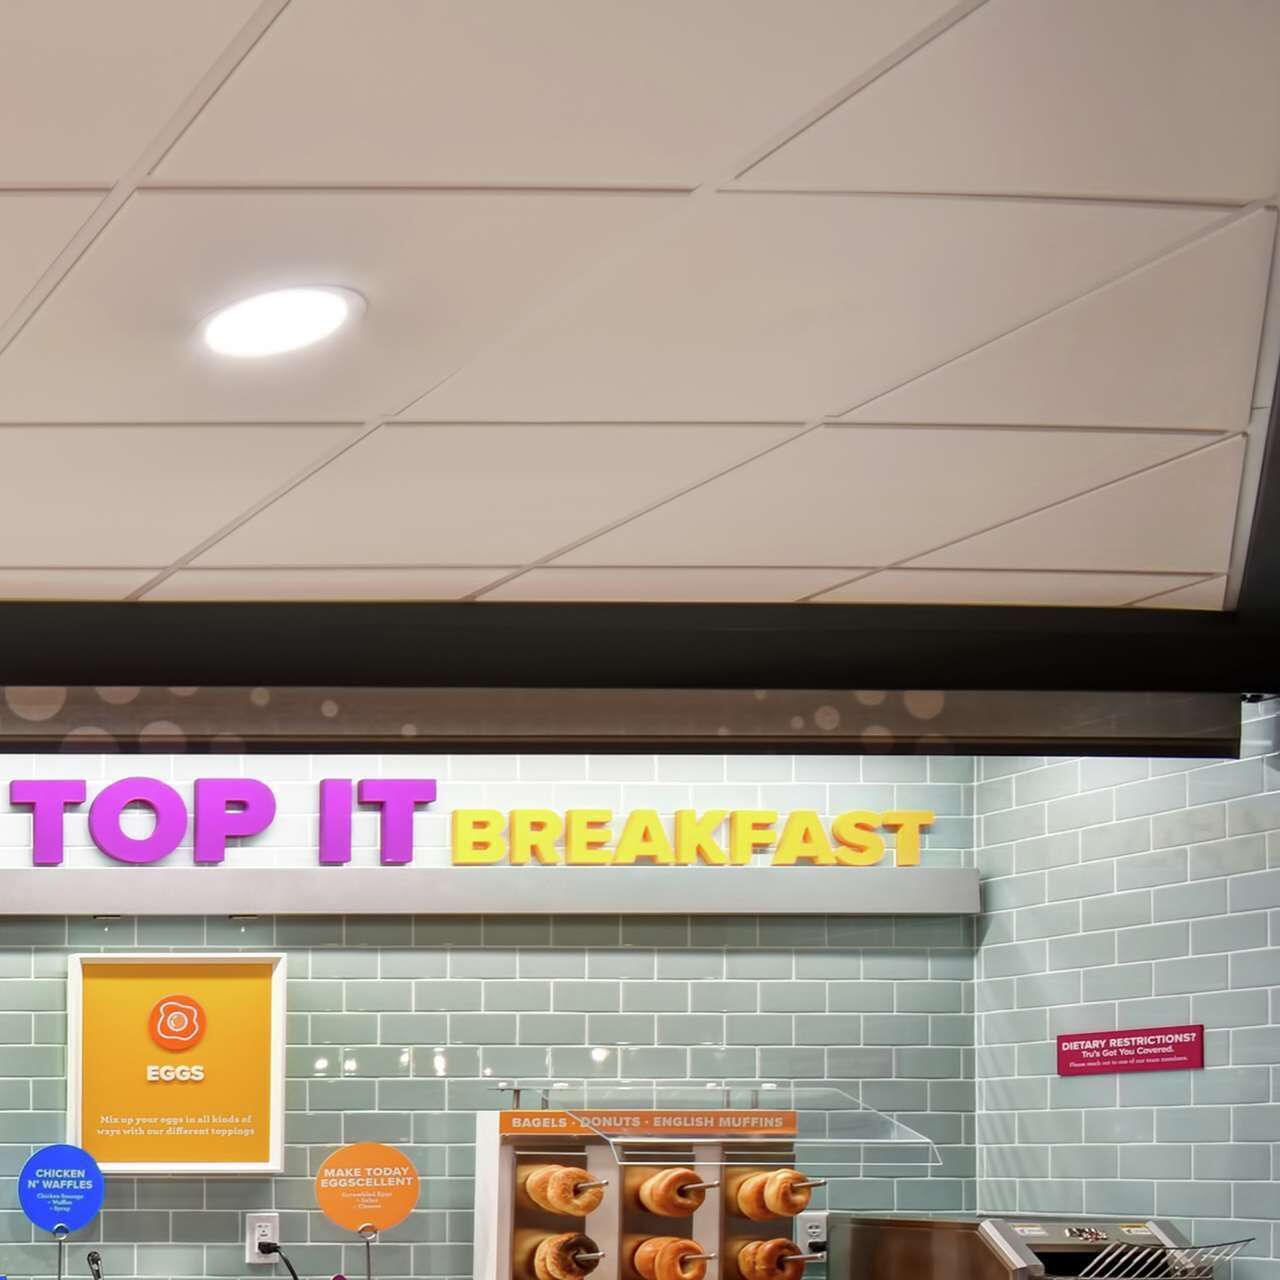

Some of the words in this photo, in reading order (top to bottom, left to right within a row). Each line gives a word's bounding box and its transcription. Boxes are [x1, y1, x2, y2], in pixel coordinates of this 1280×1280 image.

[10, 776, 276, 866] TOP
[319, 778, 436, 866] IT
[451, 807, 935, 867] BREAKFAST
[1062, 1039, 1107, 1051] DIETARY
[1109, 1033, 1196, 1049] RESTRICTIONS?
[1102, 1049, 1118, 1057] Got
[1120, 1047, 1135, 1056] You
[1137, 1045, 1175, 1055] Covered.
[147, 1065, 205, 1081] EGGS
[100, 1115, 120, 1124] Mix
[121, 1116, 135, 1126] up
[136, 1116, 160, 1126] your
[161, 1116, 184, 1126] eggs
[186, 1115, 196, 1124] in
[197, 1115, 211, 1124] all
[212, 1115, 240, 1124] kinds
[242, 1115, 253, 1124] of
[511, 1116, 568, 1128] BAGELS
[580, 1116, 641, 1128] DONUTS
[653, 1116, 715, 1128] ENGLISH
[718, 1116, 784, 1128] MUFFINS
[97, 1128, 122, 1138] ways
[123, 1126, 146, 1136] with
[147, 1128, 166, 1136] our
[167, 1126, 211, 1136] different
[212, 1126, 256, 1138] toppings
[35, 1168, 86, 1178] CHICKEN
[324, 1168, 362, 1178] MAKE
[364, 1167, 409, 1177] TODAY
[42, 1180, 94, 1190] WAFFLES
[320, 1177, 414, 1188] EGGSCELLENT
